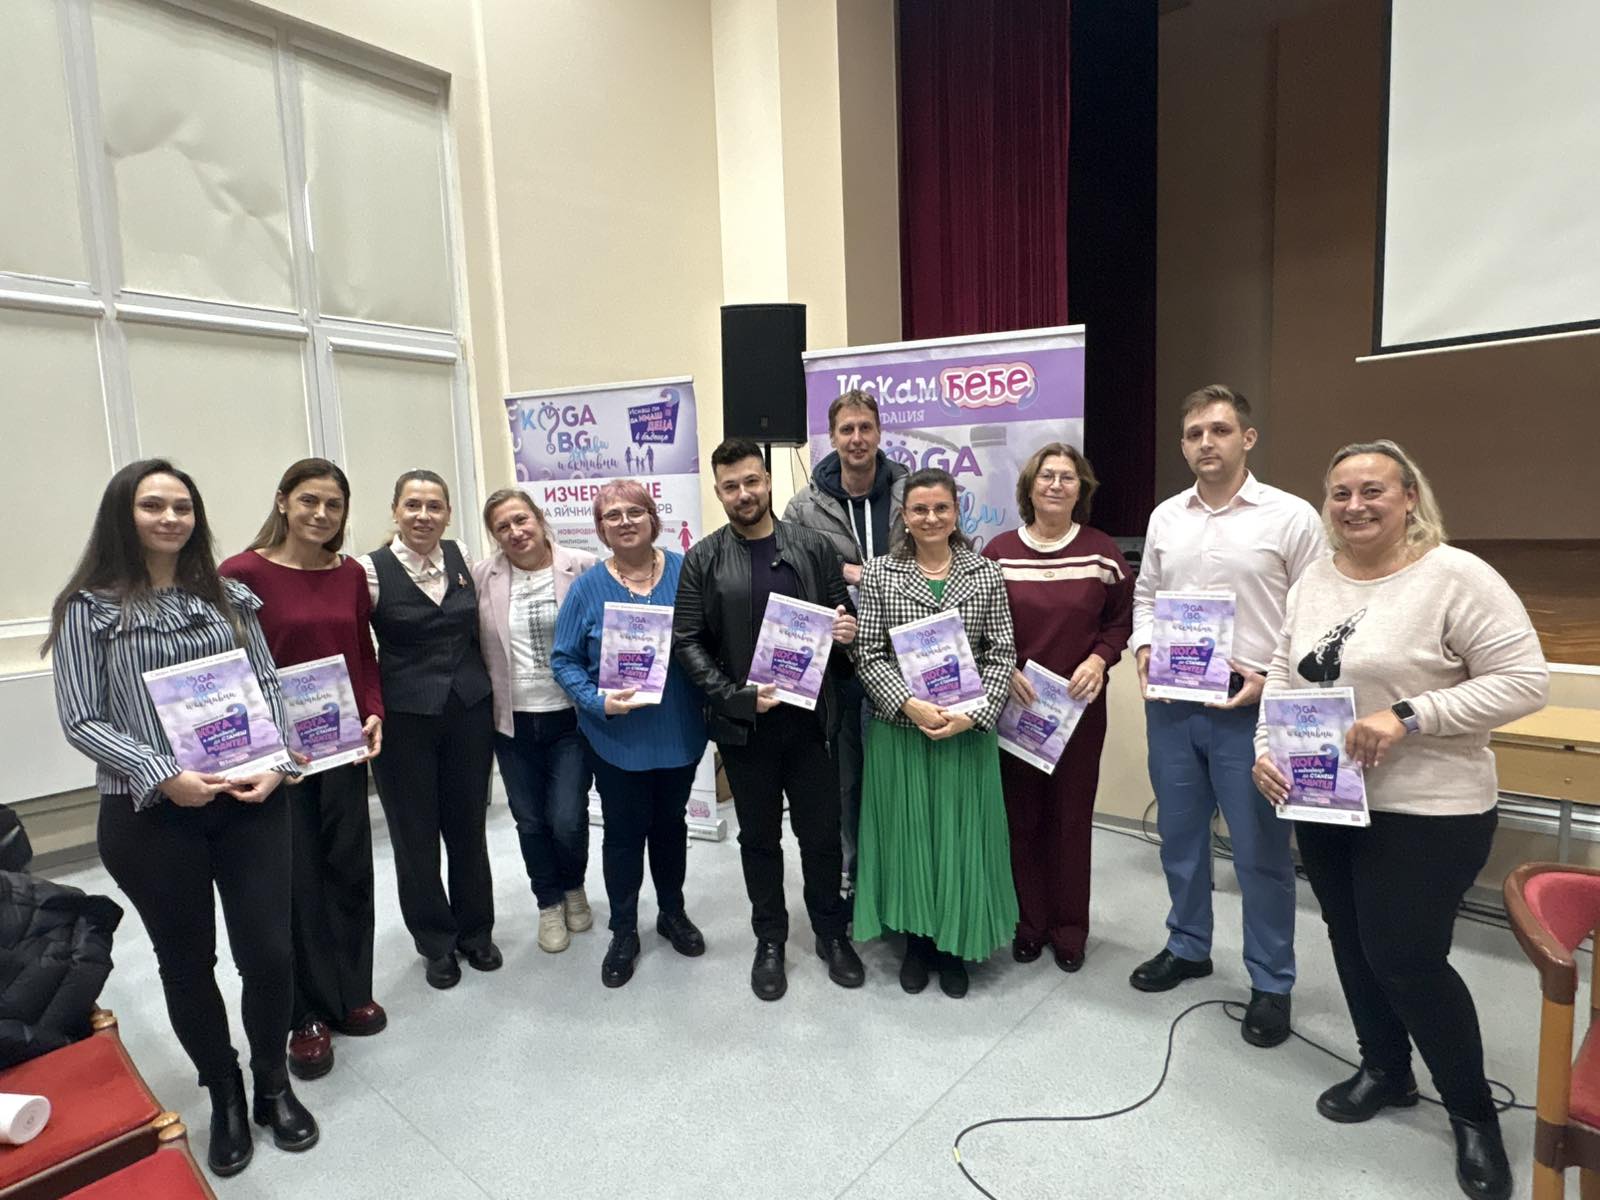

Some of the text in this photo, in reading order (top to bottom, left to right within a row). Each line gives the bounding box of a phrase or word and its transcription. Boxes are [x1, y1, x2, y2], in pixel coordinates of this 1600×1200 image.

[880, 410, 925, 425] ДАЦИЯ
[557, 430, 591, 453] BG
[885, 440, 983, 477] OGA
